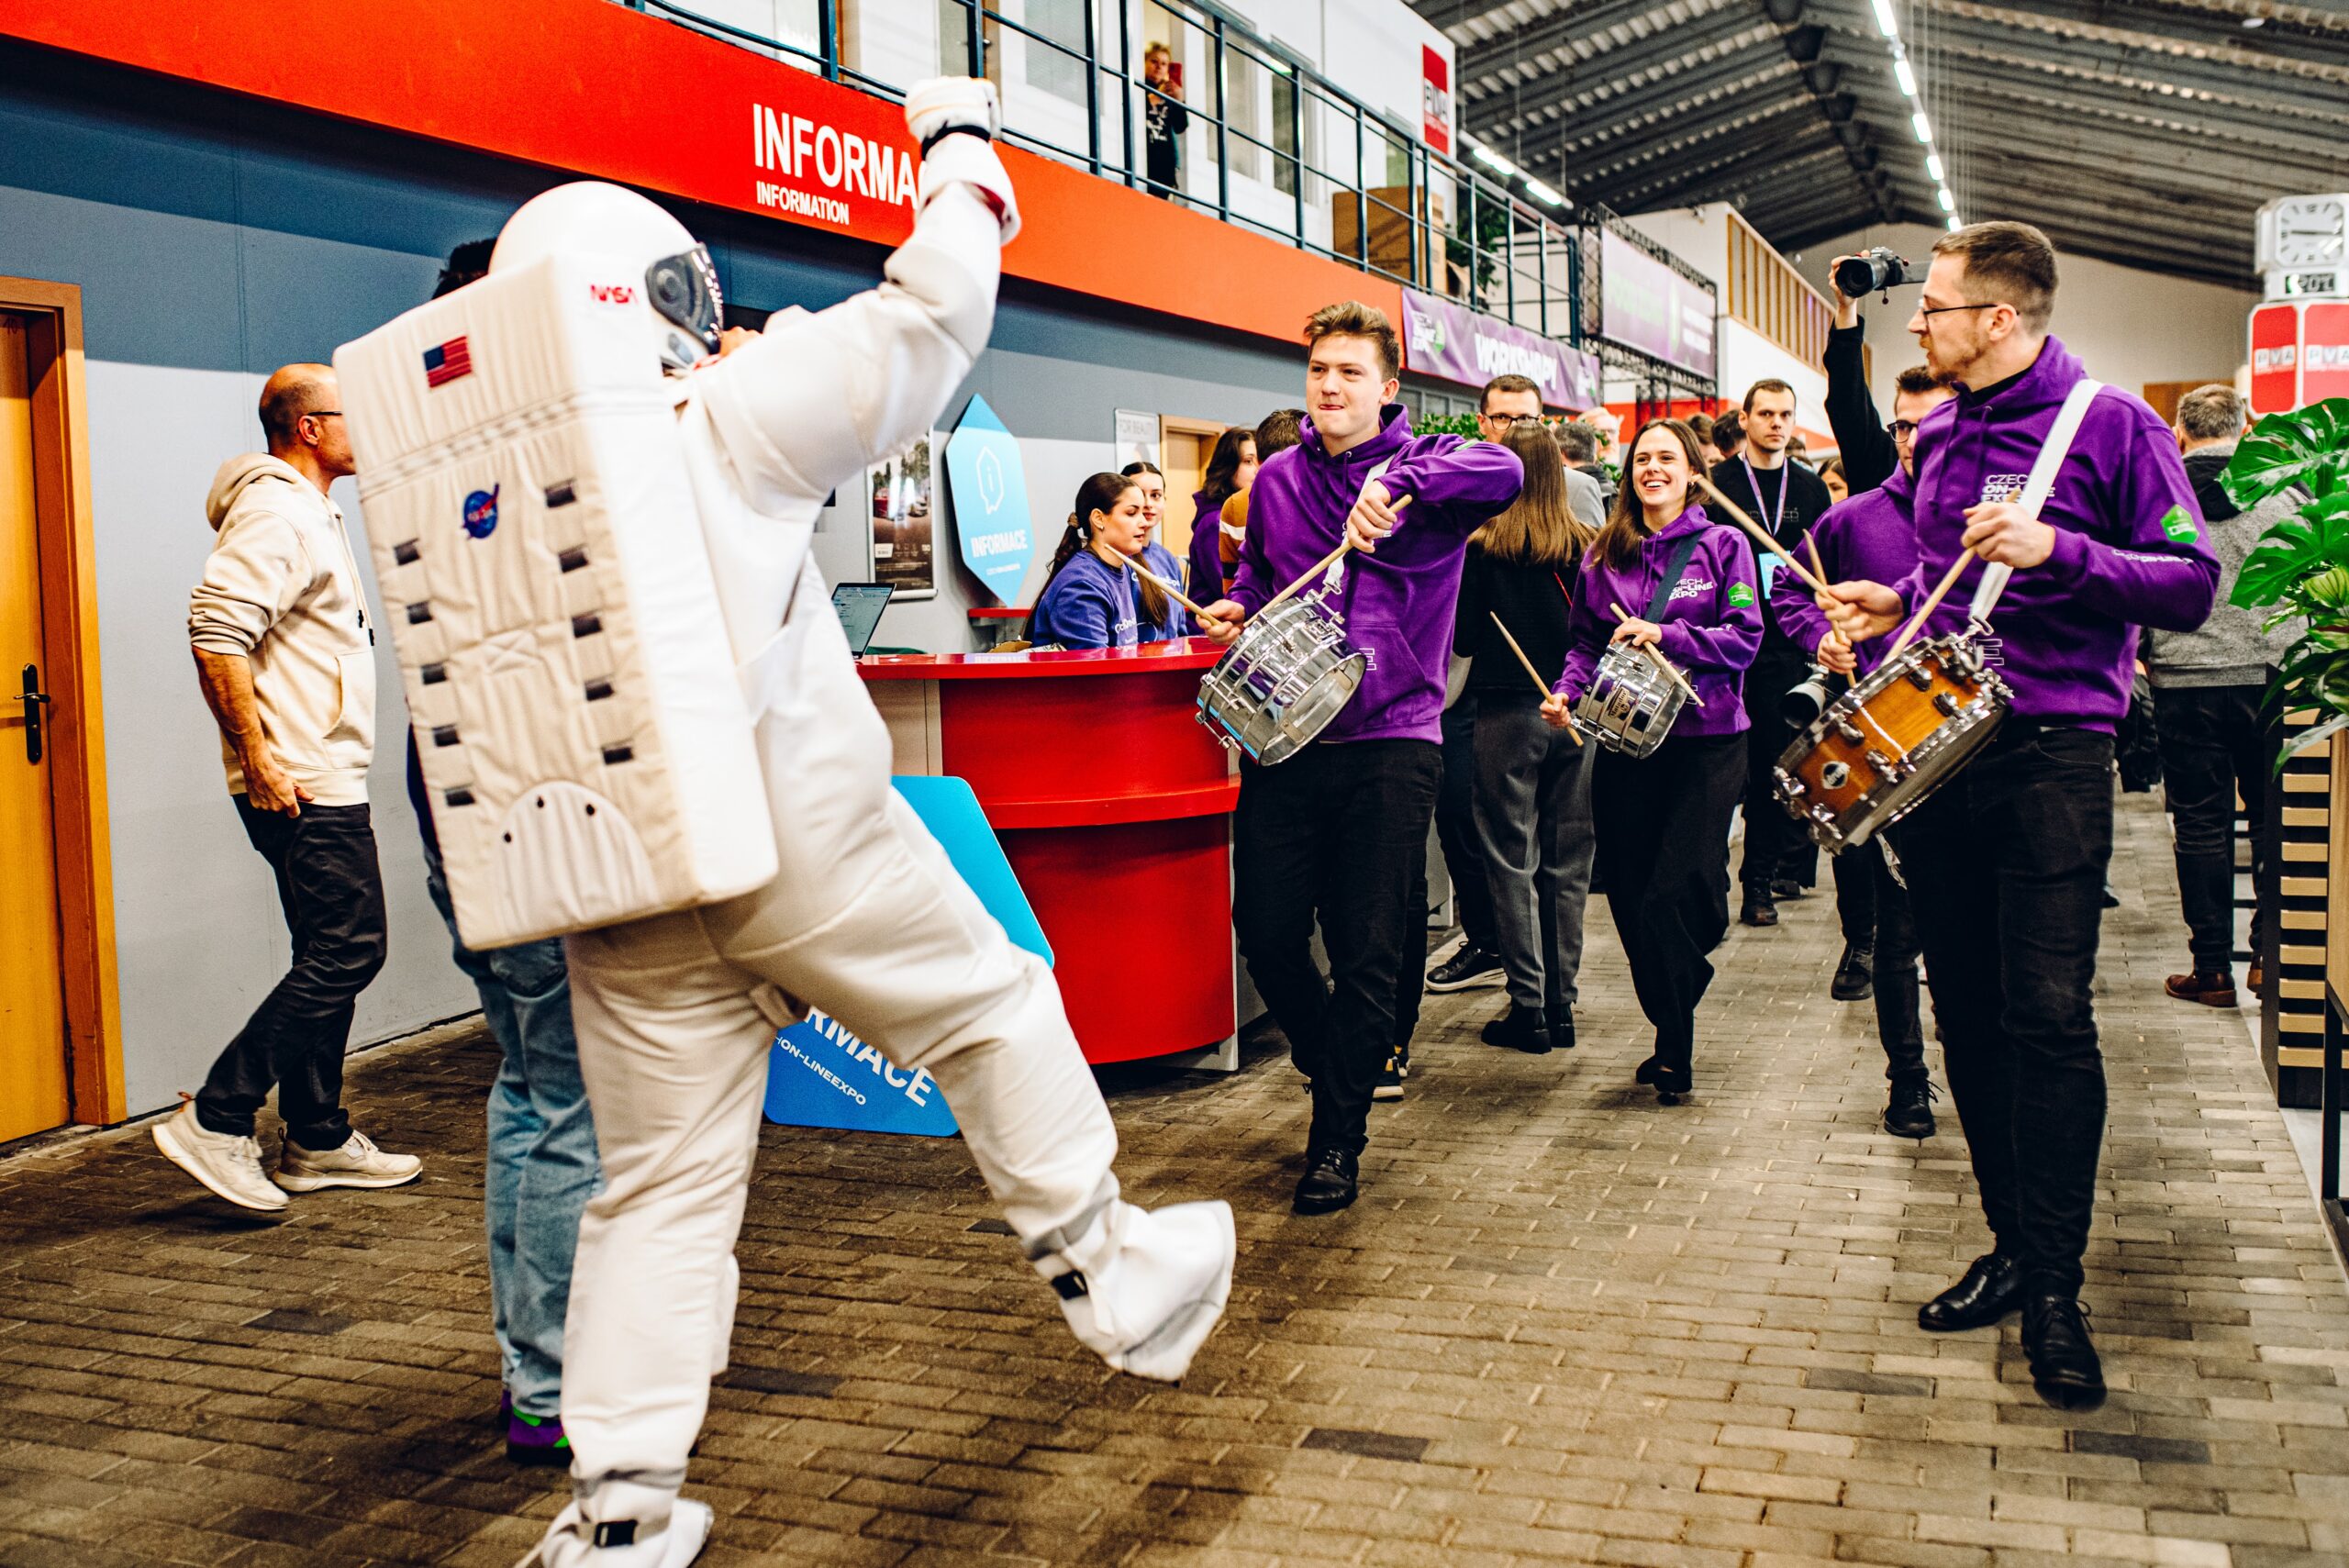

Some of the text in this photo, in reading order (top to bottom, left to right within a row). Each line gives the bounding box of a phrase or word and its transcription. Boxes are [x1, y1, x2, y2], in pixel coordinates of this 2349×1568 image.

[752, 103, 926, 210] INFORMA
[756, 181, 850, 226] INFORMATION
[590, 284, 638, 305] NASA
[1475, 333, 1557, 391] WORKSHOPY
[1985, 473, 2029, 484] CZEC
[971, 529, 1028, 558] INFORMACE
[804, 1006, 936, 1107] RMACE
